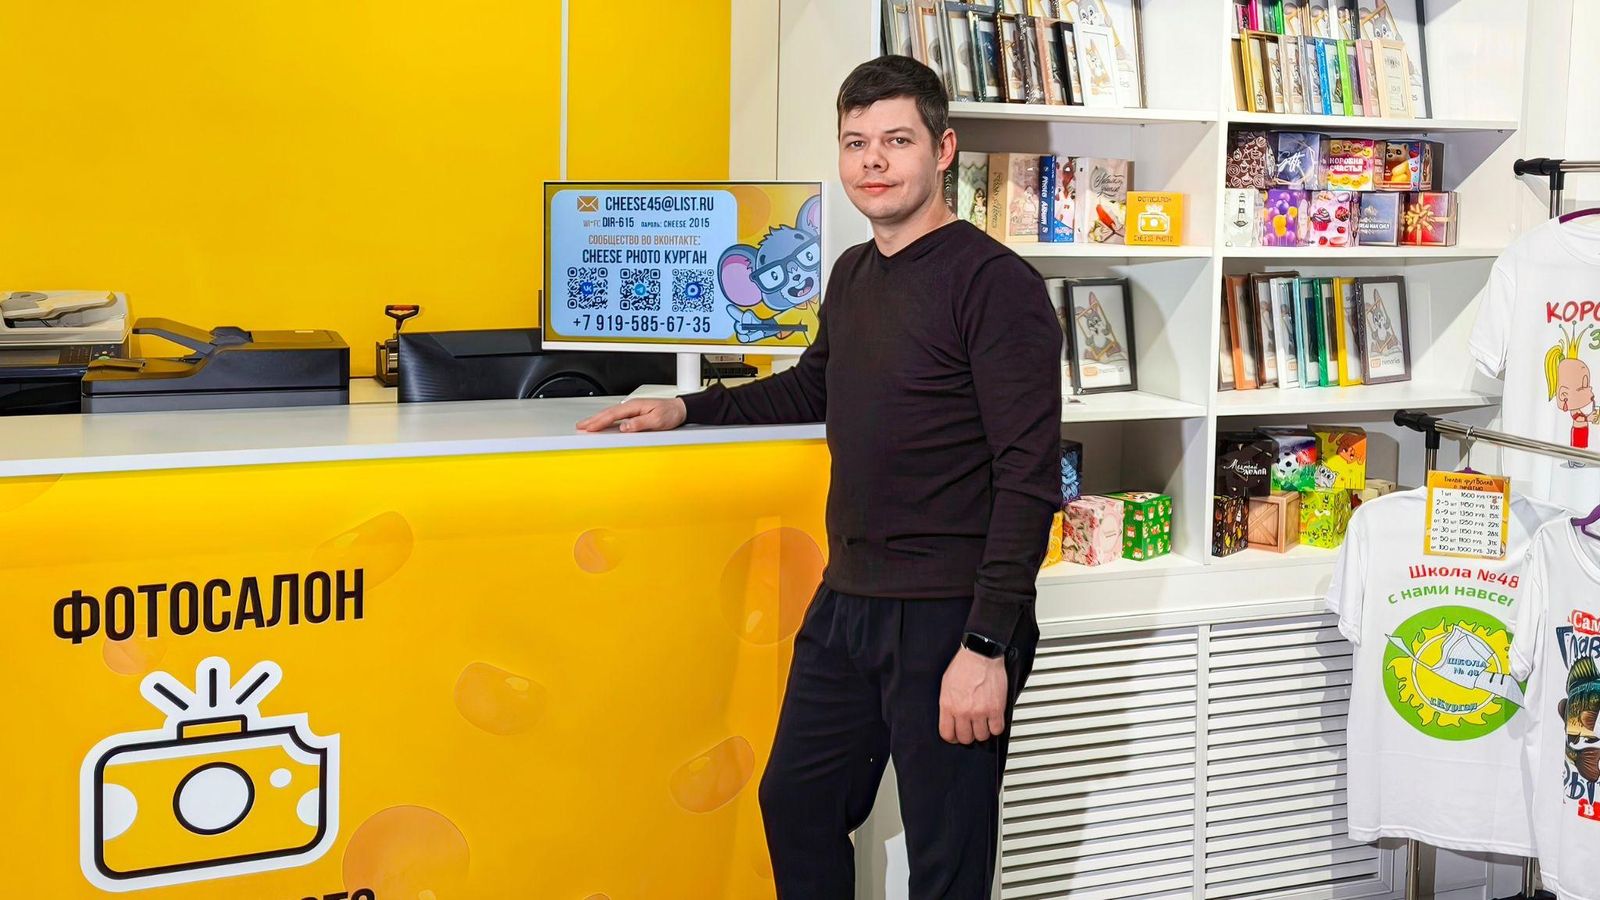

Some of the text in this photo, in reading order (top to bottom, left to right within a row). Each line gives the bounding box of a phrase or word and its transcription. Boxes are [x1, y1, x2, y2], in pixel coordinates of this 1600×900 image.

[605, 196, 714, 212] CHEESE45@LIST.RU
[602, 217, 634, 228] DIR-615
[664, 220, 686, 228] CHEESE
[689, 218, 710, 228] 2015
[588, 234, 701, 245] СООБЩЕСТВО ВО ВКОНТАКТЕ:
[582, 250, 707, 264] CHEESE PHOTO КУРГАН
[573, 314, 710, 332] +7 919-585-67-35
[1408, 564, 1520, 589] Школа №48
[1388, 593, 1398, 604] с
[1400, 584, 1449, 600] нами
[52, 568, 364, 644] ФОТОСАЛОН
[1447, 657, 1487, 669] ШКОЛА
